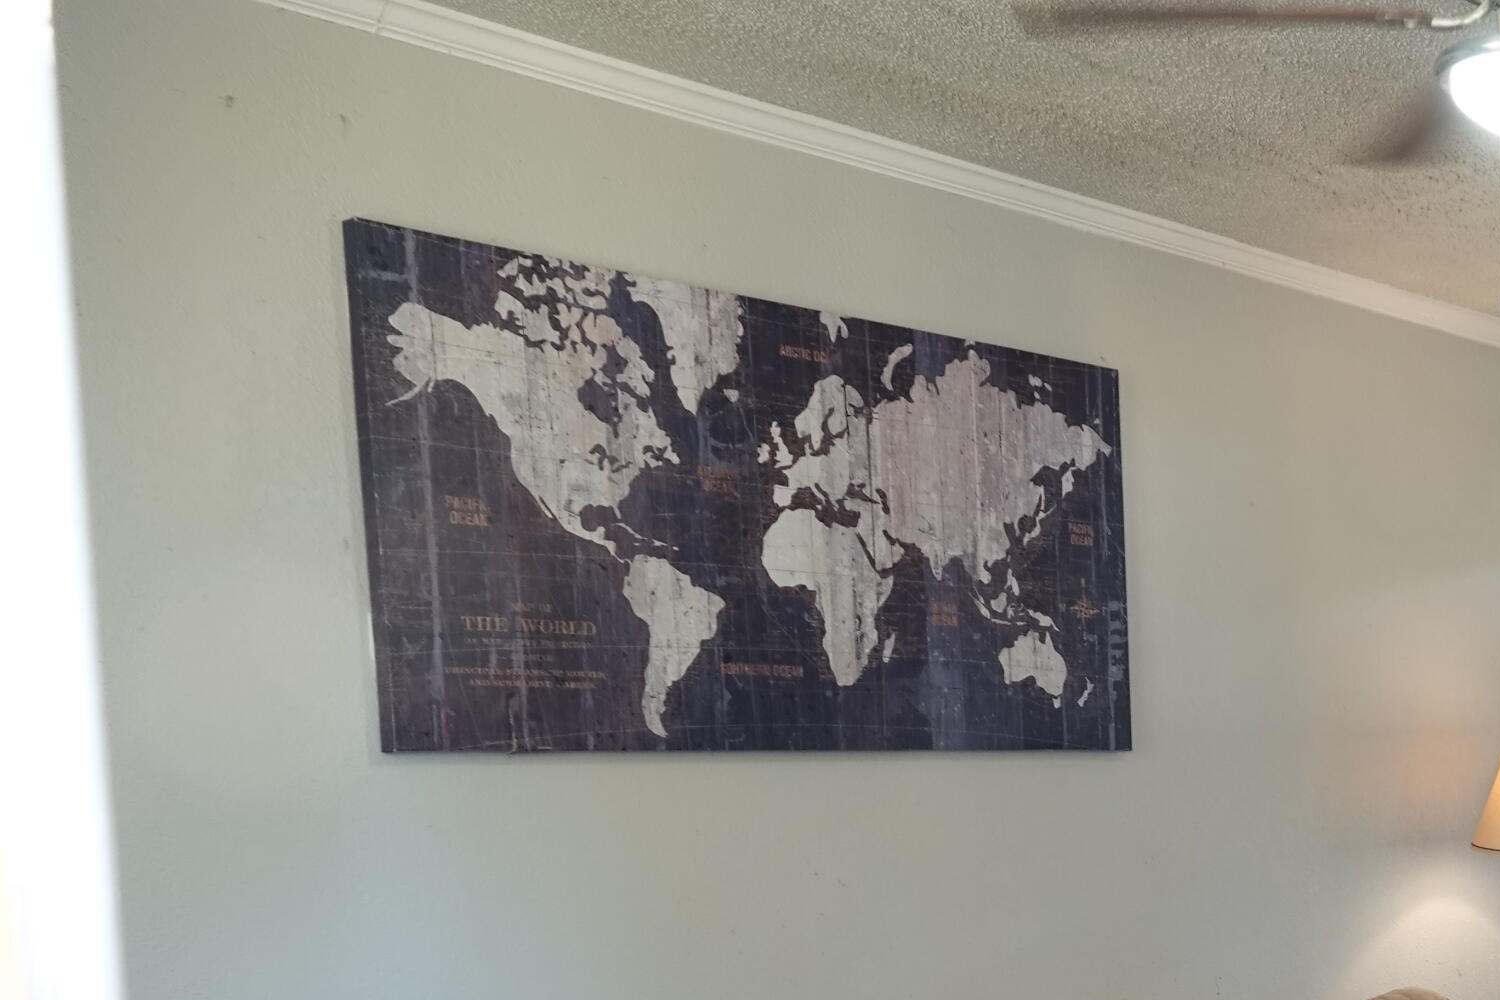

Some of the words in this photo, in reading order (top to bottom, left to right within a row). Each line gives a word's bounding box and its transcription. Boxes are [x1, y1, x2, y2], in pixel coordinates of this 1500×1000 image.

[449, 510, 489, 527] OCEAN
[460, 615, 509, 632] THE
[515, 618, 598, 636] WORLD
